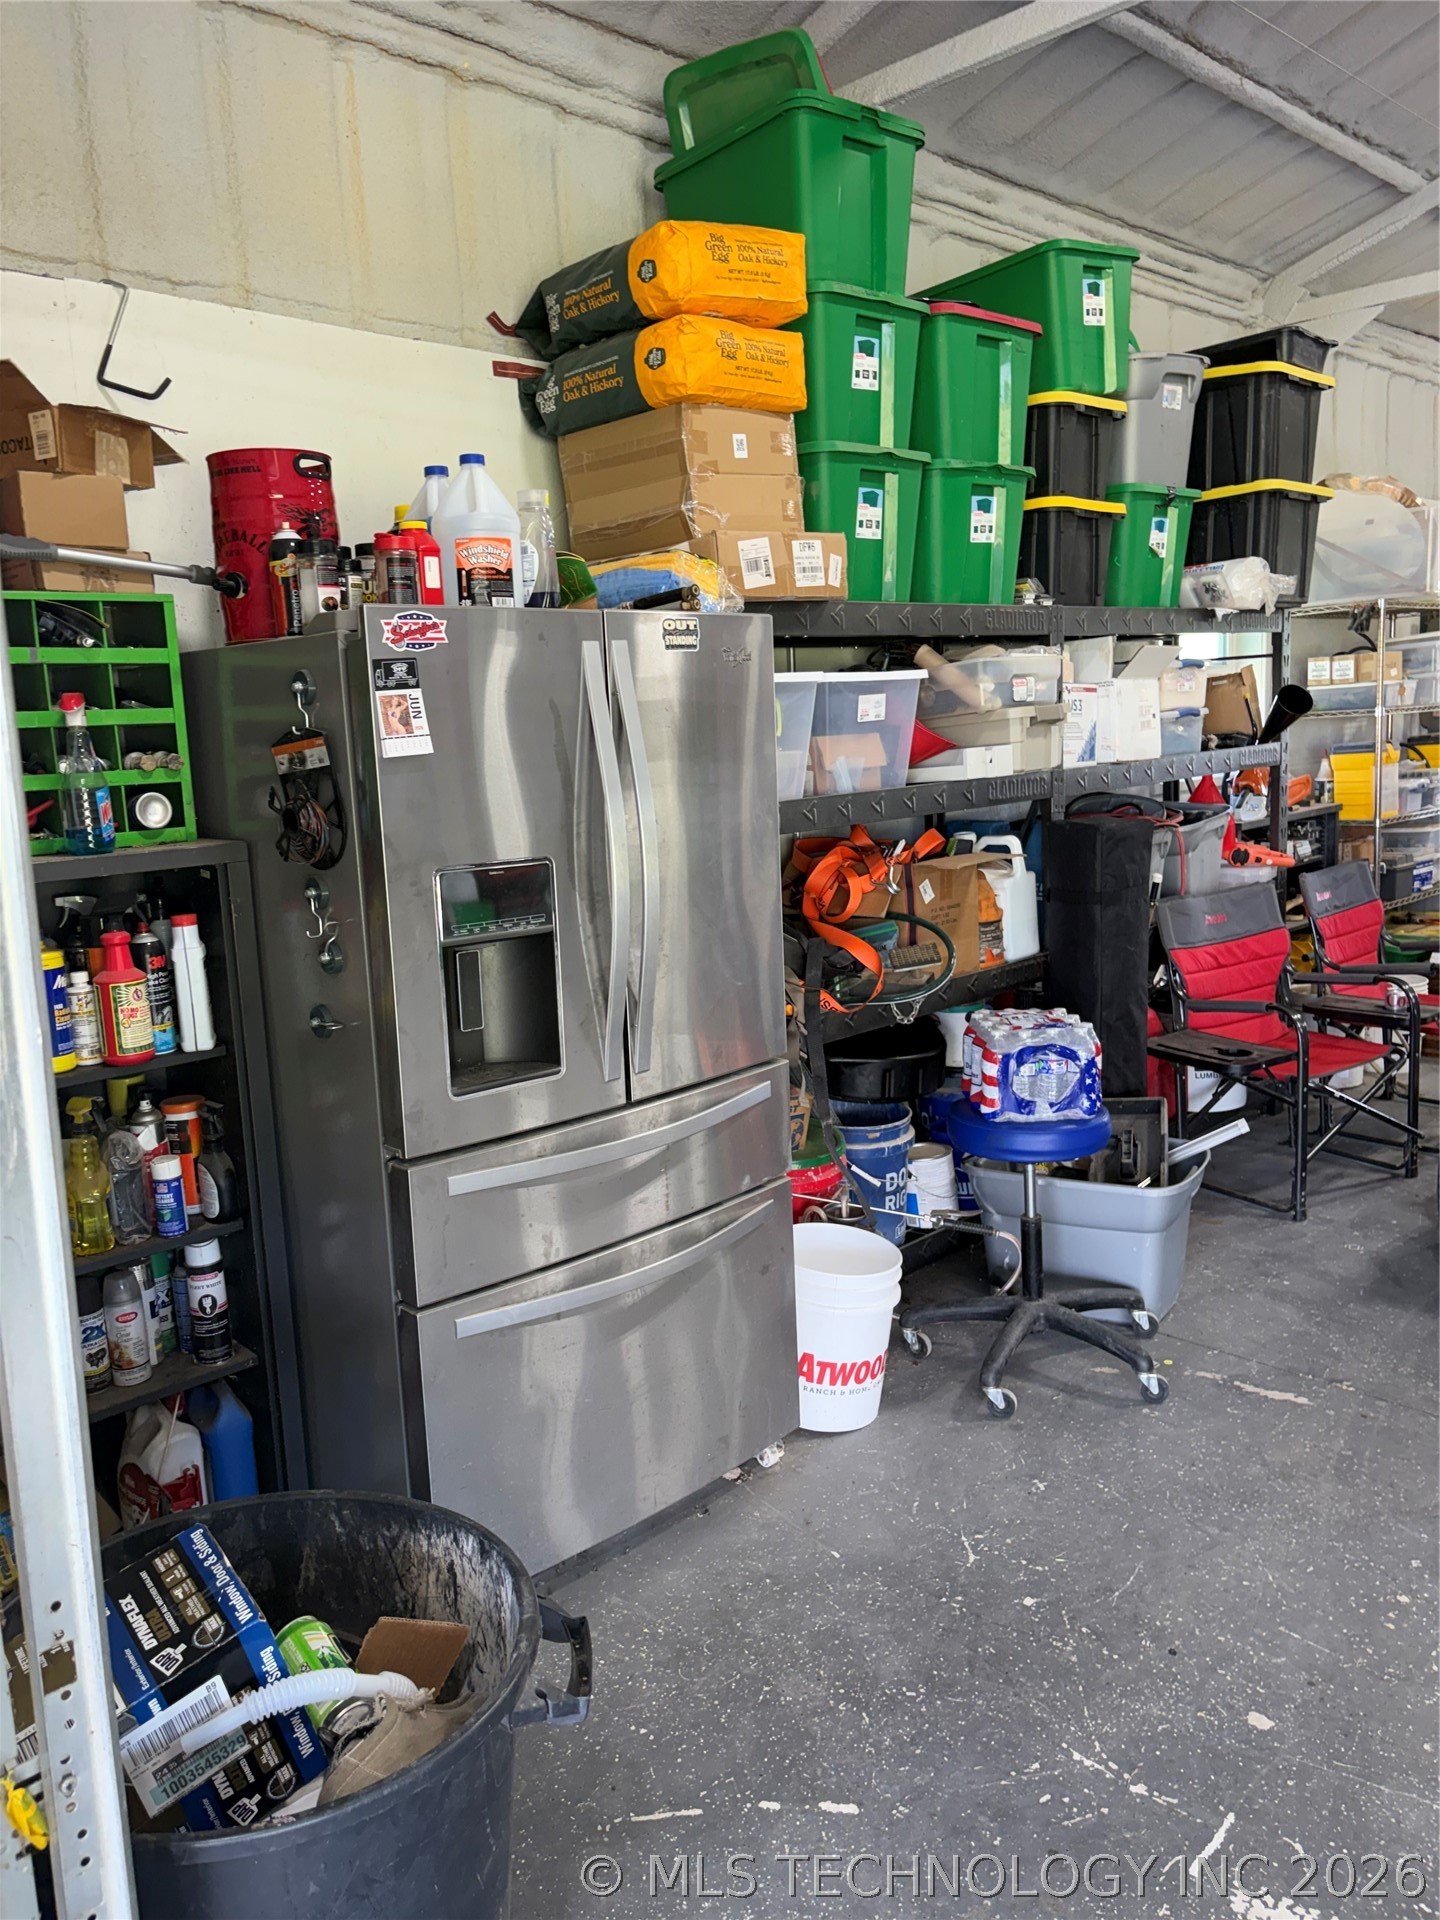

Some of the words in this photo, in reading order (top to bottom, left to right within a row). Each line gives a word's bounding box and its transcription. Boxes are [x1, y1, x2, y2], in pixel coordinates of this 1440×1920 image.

[705, 240, 733, 252] Green
[709, 232, 725, 246] Big
[712, 250, 729, 264] Egg
[737, 244, 756, 254] 100%
[757, 246, 784, 257] Natural
[738, 253, 754, 263] Oak
[755, 256, 761, 264] &
[763, 255, 788, 268] Hickory
[582, 277, 612, 298] Natural
[562, 307, 580, 320] Oak
[580, 302, 588, 314] &
[587, 290, 620, 311] Hickory
[716, 337, 741, 350] Green
[720, 329, 735, 341] Big
[721, 348, 737, 361] Egg
[744, 343, 762, 352] 100%
[763, 346, 786, 357] Natural
[746, 351, 760, 361] Oak
[760, 354, 766, 362] &
[766, 354, 789, 368] Hickory
[563, 378, 583, 391] 100%
[584, 363, 617, 382] Natural
[563, 390, 581, 403] Oak
[581, 386, 589, 397] &
[590, 375, 624, 394] Hickory
[459, 543, 510, 560] Windshield
[467, 554, 502, 567] Washer
[663, 619, 697, 630] OUT
[984, 608, 1046, 632] GLADIATOR
[664, 635, 697, 646] STANDING
[408, 693, 423, 719] JUN
[1240, 746, 1279, 765] GLADIATOR
[988, 774, 1048, 800] GLADIATOR
[885, 1167, 907, 1193] DO
[803, 1385, 837, 1396] RANCH
[839, 1388, 846, 1396] &
[190, 1528, 213, 1559] Siding
[203, 1555, 218, 1567] &
[139, 1569, 154, 1589] SEALANT
[210, 1562, 229, 1587] Door
[148, 1586, 164, 1605] WEATHER
[224, 1581, 254, 1625] Window,
[185, 1607, 193, 1616] ALL
[186, 1597, 202, 1619] WEATHER
[118, 1592, 158, 1651] DYNAFLEX
[145, 1607, 172, 1643] ULTRA
[162, 1609, 181, 1635] ADVANCED
[124, 1648, 149, 1691] Exterior/Interior
[155, 1650, 181, 1673] DAP
[260, 1646, 282, 1686] Siding
[288, 1712, 315, 1759] Window,
[160, 1734, 247, 1800] 1003545329
